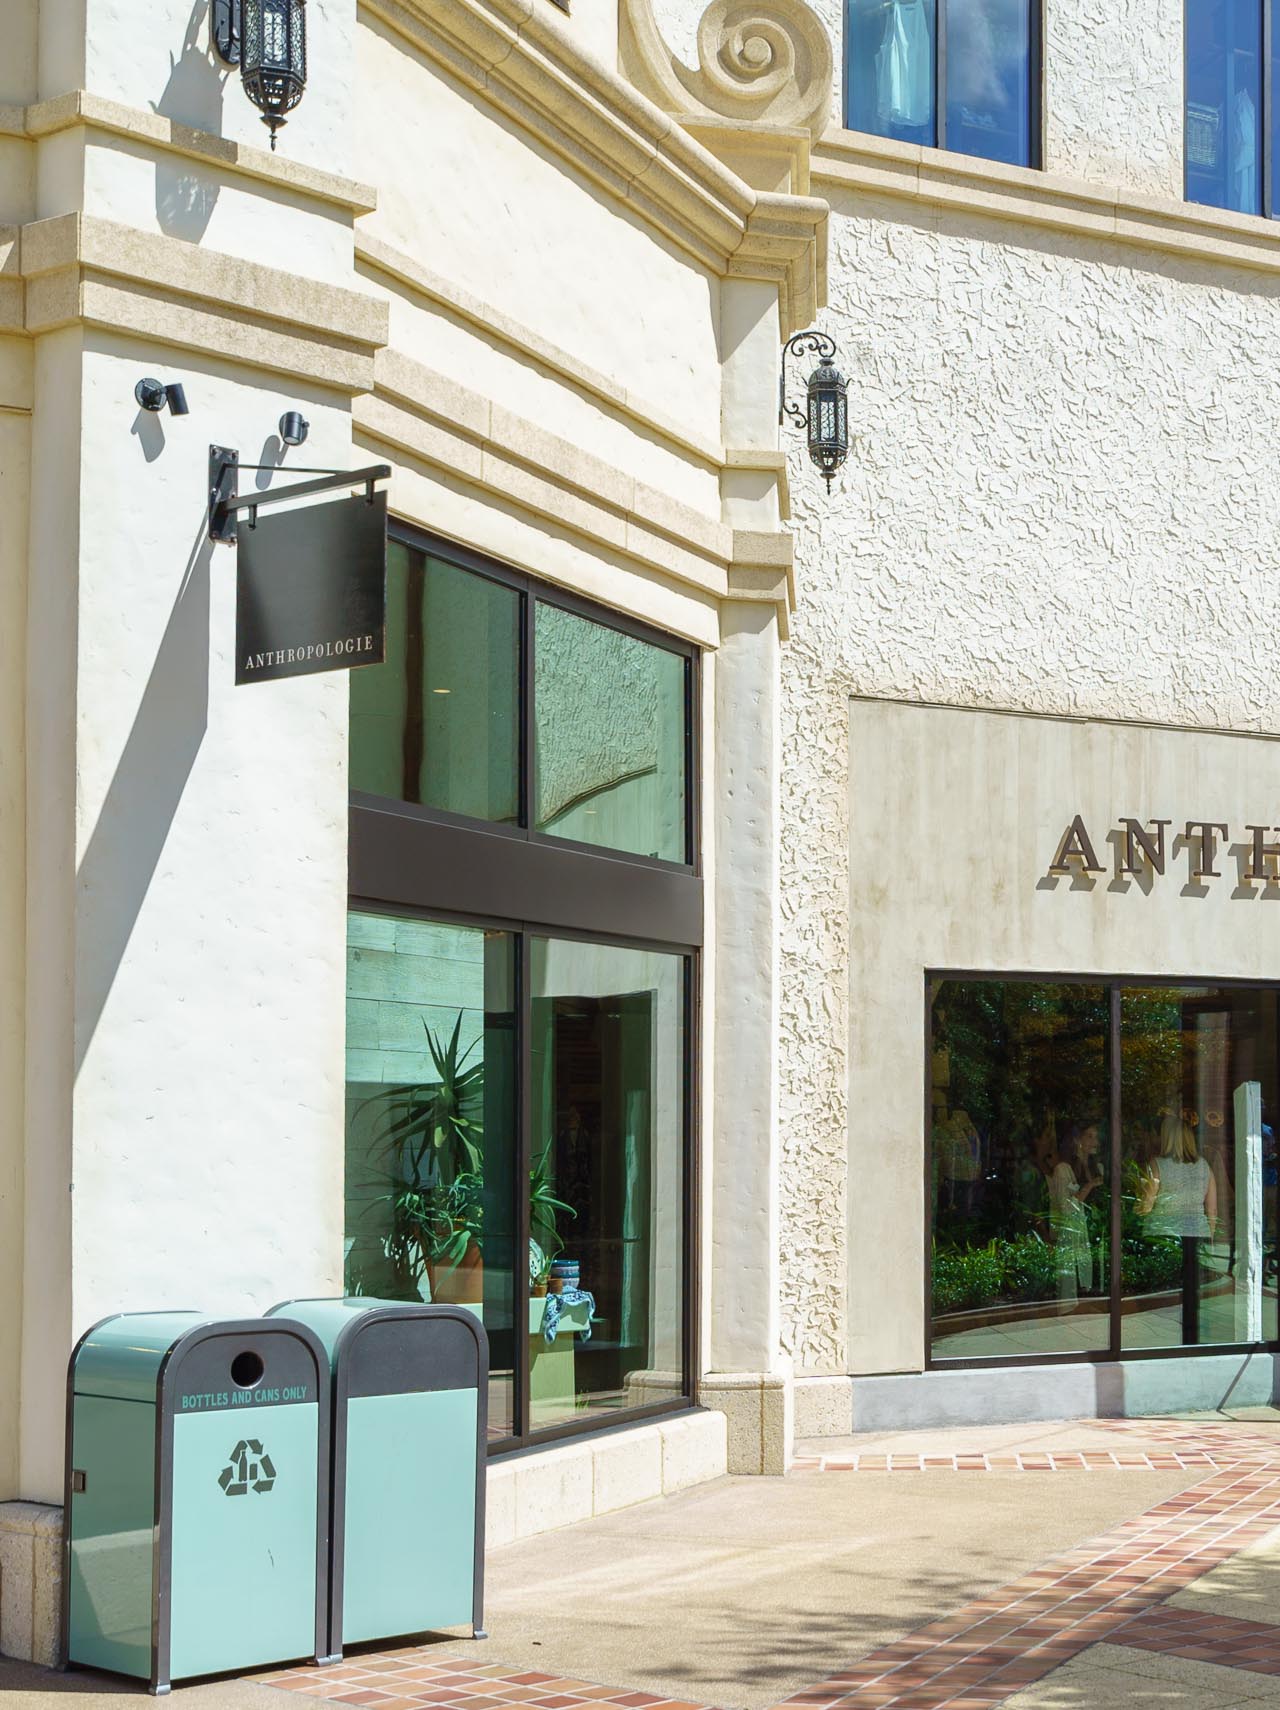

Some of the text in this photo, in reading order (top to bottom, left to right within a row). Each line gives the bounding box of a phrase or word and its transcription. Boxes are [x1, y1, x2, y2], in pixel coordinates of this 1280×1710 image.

[245, 635, 373, 670] ANTHROPOLOGIE
[181, 1386, 307, 1409] BOTTLES AND CANS ONLY
